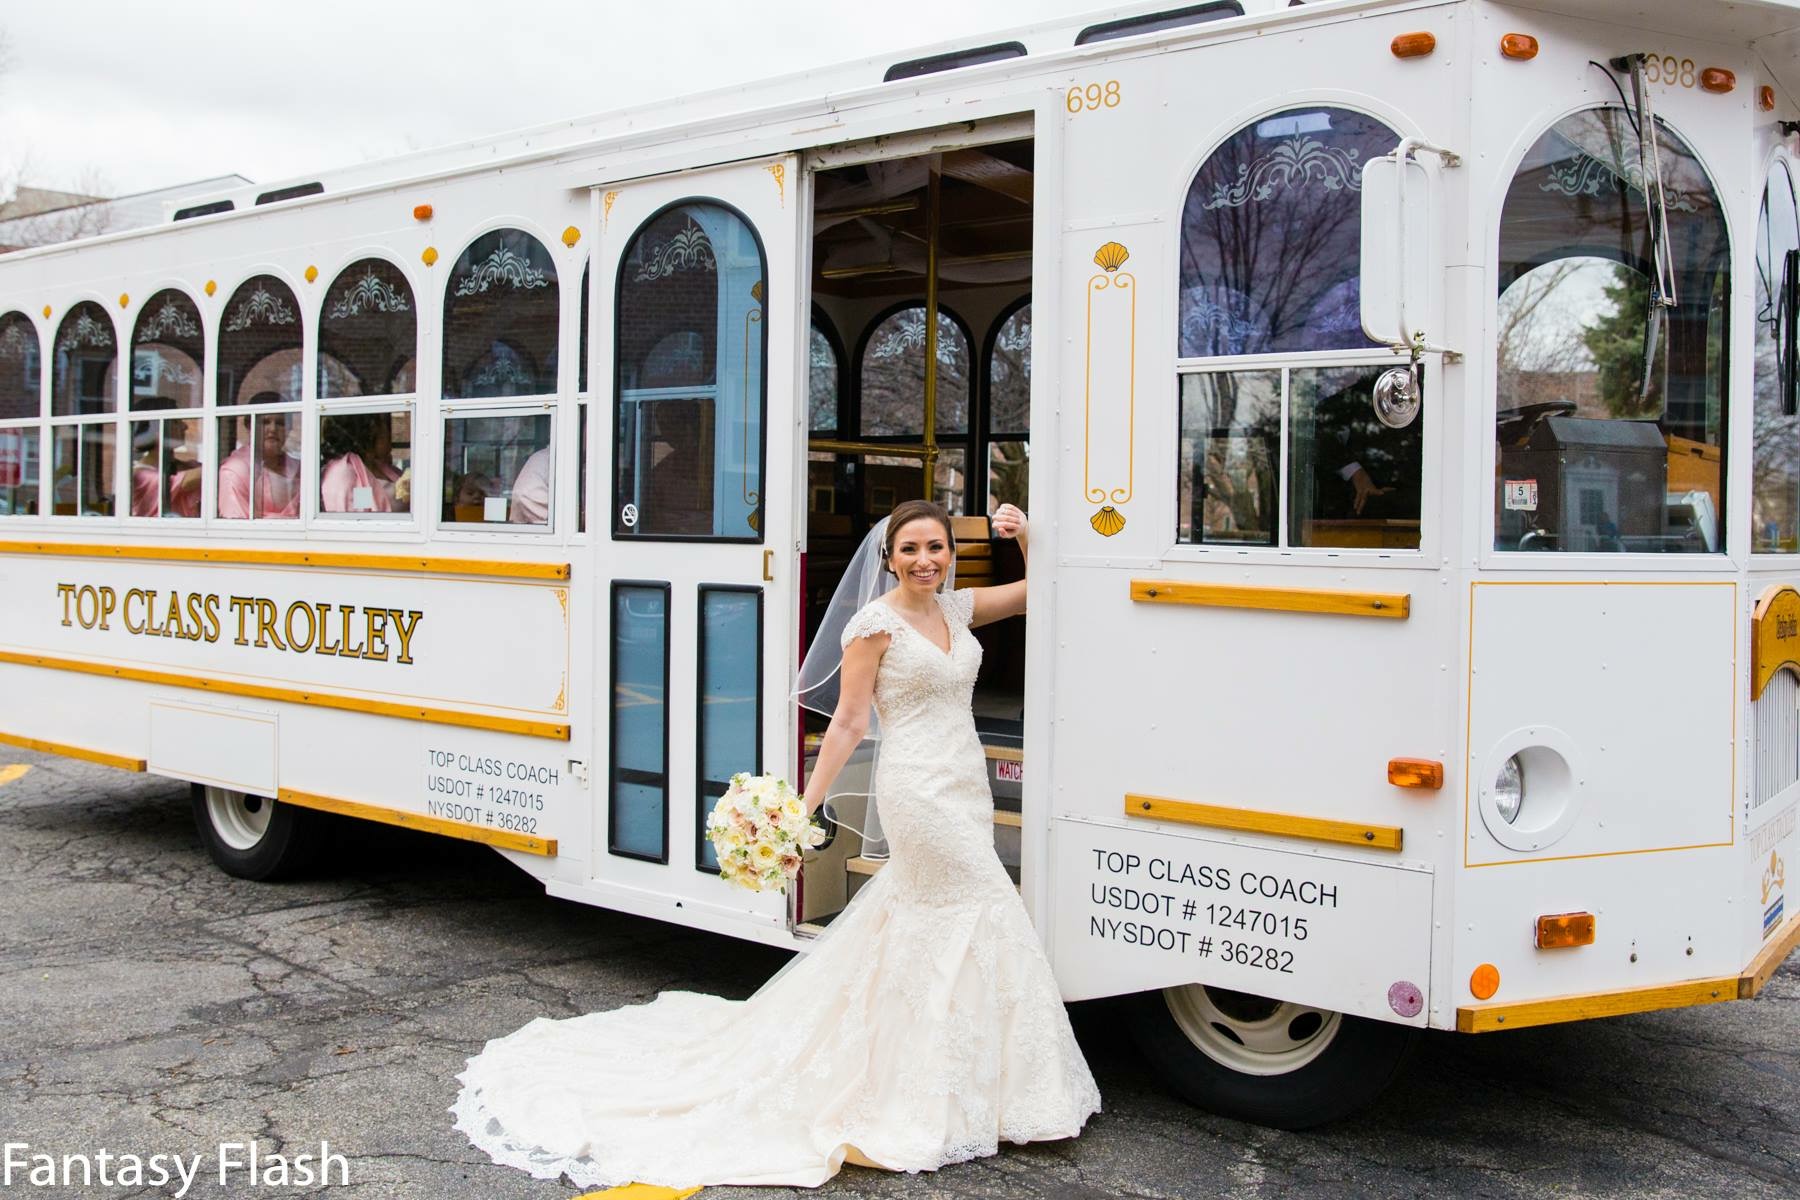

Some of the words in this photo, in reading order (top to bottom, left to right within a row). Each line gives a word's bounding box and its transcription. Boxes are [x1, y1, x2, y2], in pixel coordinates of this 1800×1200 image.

[1646, 53, 1696, 88] 698
[1067, 80, 1121, 113] 698
[1518, 486, 1524, 496] 5
[57, 583, 116, 631] TOP
[123, 588, 221, 643] CLASS
[229, 595, 423, 665] TROLLEY
[429, 749, 455, 768] TOP
[458, 754, 502, 777] CLASS
[506, 762, 559, 786] COACH
[428, 774, 472, 798] USDOT
[476, 784, 484, 800] #
[489, 786, 544, 812] 1247015
[428, 799, 482, 824] NYSDOT
[497, 811, 538, 835] 36282
[1092, 849, 1141, 876] TOP
[1149, 858, 1232, 891] CLASS
[1240, 872, 1339, 908] COACH
[1091, 883, 1176, 918] USDOT
[1182, 900, 1198, 921] #
[1206, 903, 1310, 941] 1247015
[1090, 916, 1192, 954] NYSDOT
[1198, 936, 1214, 958] #
[1221, 940, 1295, 975] 36282
